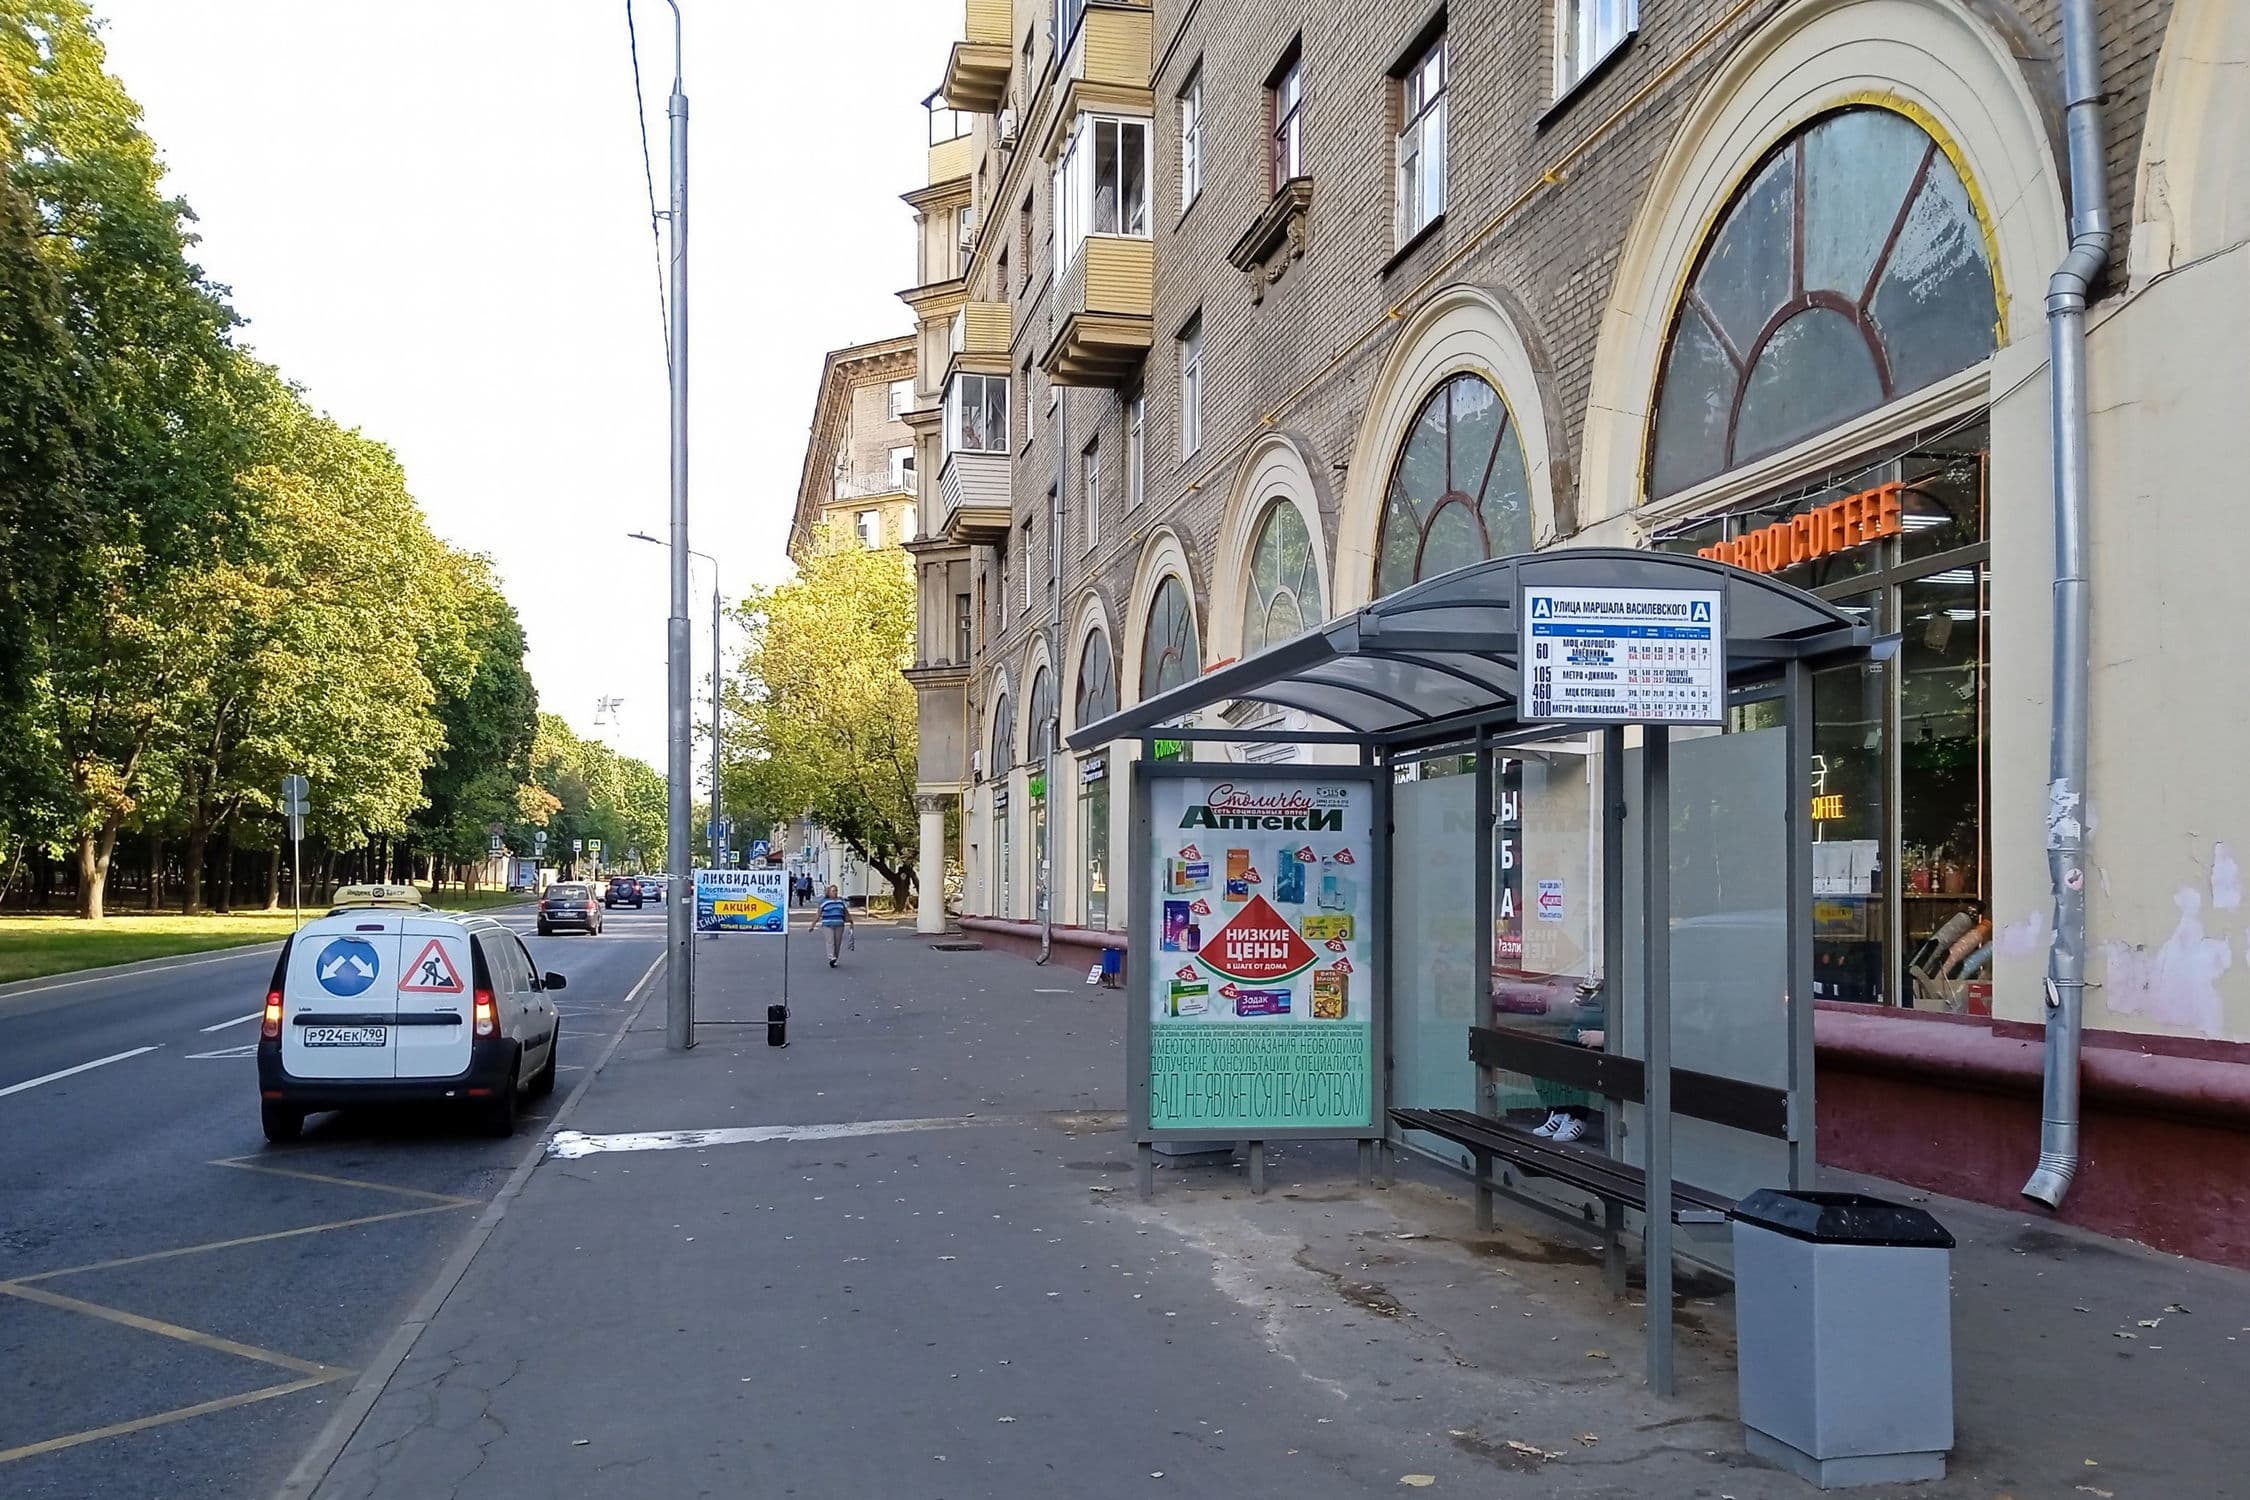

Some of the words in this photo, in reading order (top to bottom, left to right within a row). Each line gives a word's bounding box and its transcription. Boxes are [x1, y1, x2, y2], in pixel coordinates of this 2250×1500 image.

[1790, 482, 1906, 564] COFFEE
[1554, 601, 1581, 614] УЛИЦА
[1583, 602, 1624, 614] МАРШАЛА
[1626, 603, 1688, 616] ВАСИЛЕВСКОГО
[1536, 642, 1548, 660] 60
[1534, 666, 1552, 682] 105
[1562, 670, 1583, 680] МЕТРО
[1532, 684, 1552, 700] 460
[1533, 700, 1552, 717] 800
[1208, 783, 1316, 808] Столички
[1232, 808, 1283, 816] социальных
[702, 874, 781, 886] ЛИКВИДАЦИЯ
[723, 904, 758, 912] АКЦИЯ
[1226, 928, 1289, 941] НИЗКИЕ
[1227, 943, 1288, 962] ЦЕНЫ
[1242, 996, 1268, 1004] Зодак
[363, 1029, 382, 1038] 790
[1151, 1039, 1196, 1054] ИМЕЮТСЯ
[1199, 1039, 1298, 1054] ПРОТИВОПОКАЗАНИЯ.
[1301, 1039, 1363, 1055] НЕОБХОДИМО
[1151, 1056, 1208, 1072] ПОЛУЧЕНИЕ
[1214, 1056, 1289, 1072] КОНСУЛЬТАЦИИ
[1296, 1056, 1363, 1072] СПЕЦИАЛИСТА
[1151, 1073, 1182, 1120] БАД.
[1185, 1074, 1203, 1118] НЕ
[1205, 1073, 1272, 1118] ЯВЛЯЕТСЯ
[1274, 1073, 1363, 1118] ЛЕКАРСТВОМ
